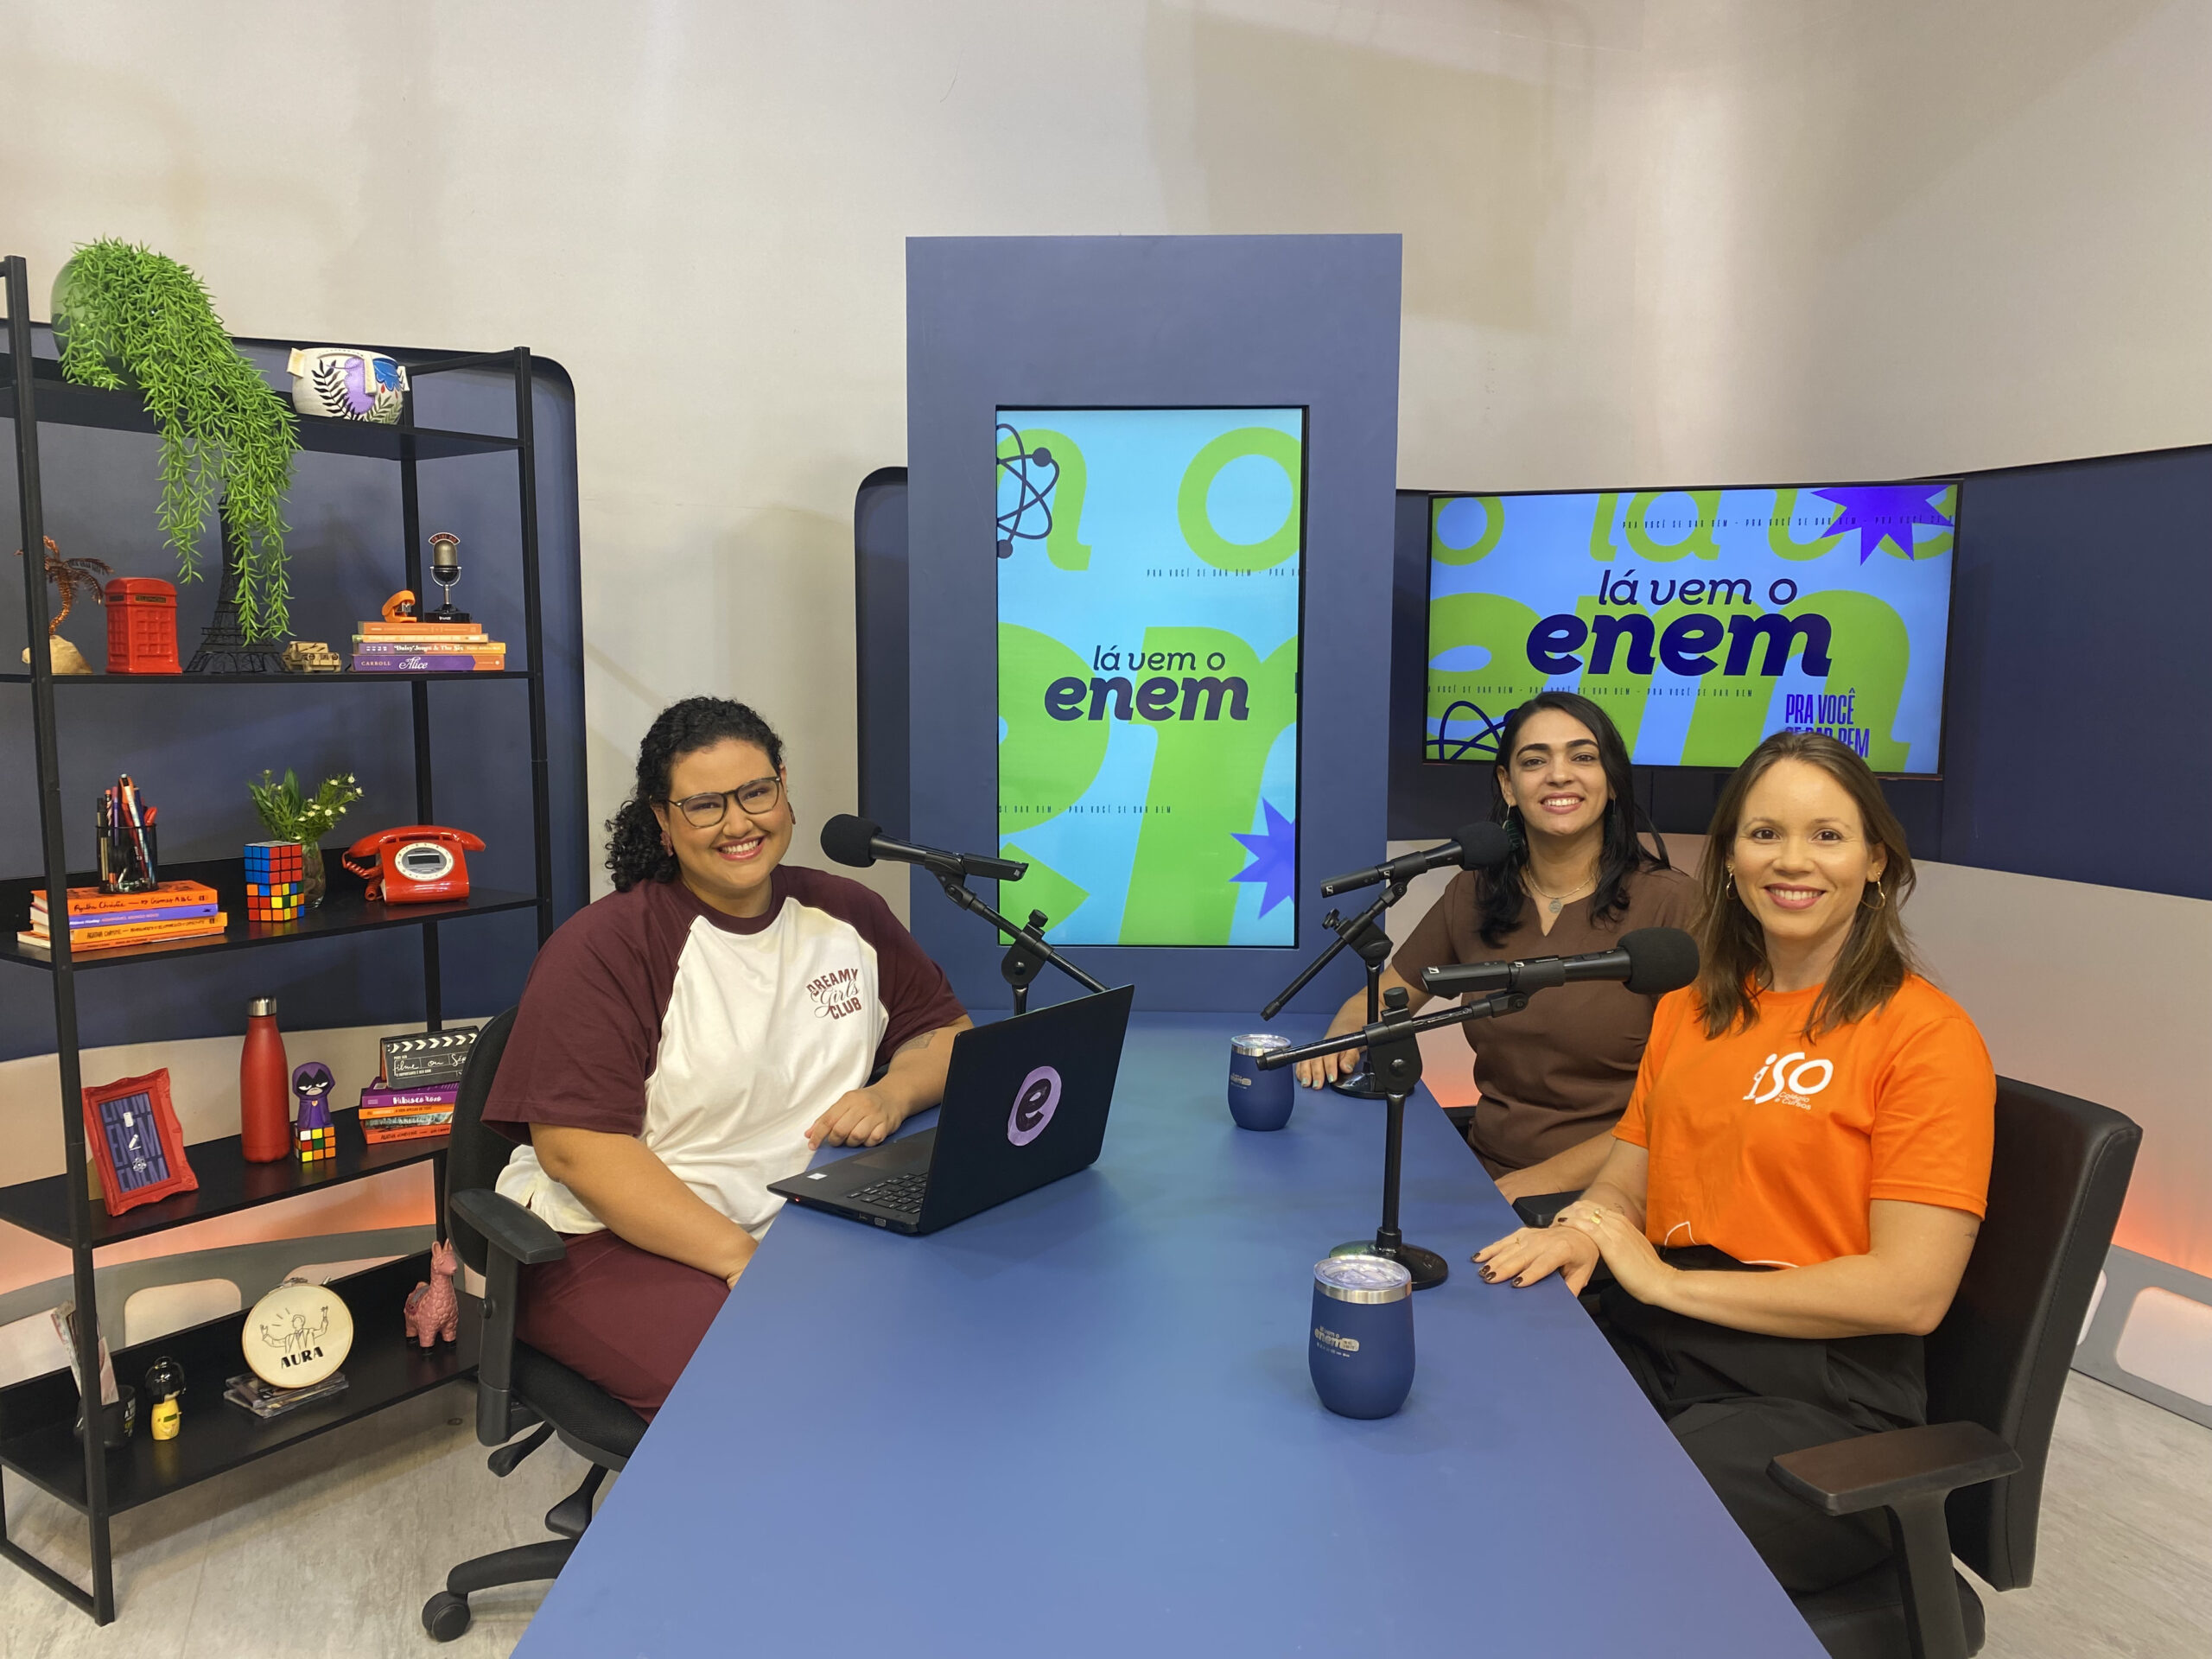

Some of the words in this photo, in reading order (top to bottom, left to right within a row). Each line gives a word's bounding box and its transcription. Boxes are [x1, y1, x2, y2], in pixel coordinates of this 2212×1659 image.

[1644, 519, 1665, 529] VOCÊ
[1147, 569, 1162, 577] PRA
[1197, 569, 1205, 577] SE
[1598, 569, 1639, 605] lá
[1649, 577, 1752, 606] vem
[1769, 578, 1797, 606] o
[1093, 645, 1122, 671] lá
[1128, 651, 1198, 671] vem
[1206, 651, 1226, 671] o
[1526, 613, 1833, 677] enem
[398, 657, 429, 670] Alice
[1044, 676, 1249, 721] enem
[1785, 694, 1814, 724] PRA
[1818, 687, 1856, 725] VOCÊ
[806, 968, 859, 997] DREAMY
[810, 978, 860, 1018] Girls
[830, 997, 862, 1020] CLUB
[1015, 1077, 1052, 1132] e
[281, 1346, 324, 1369] AURA
